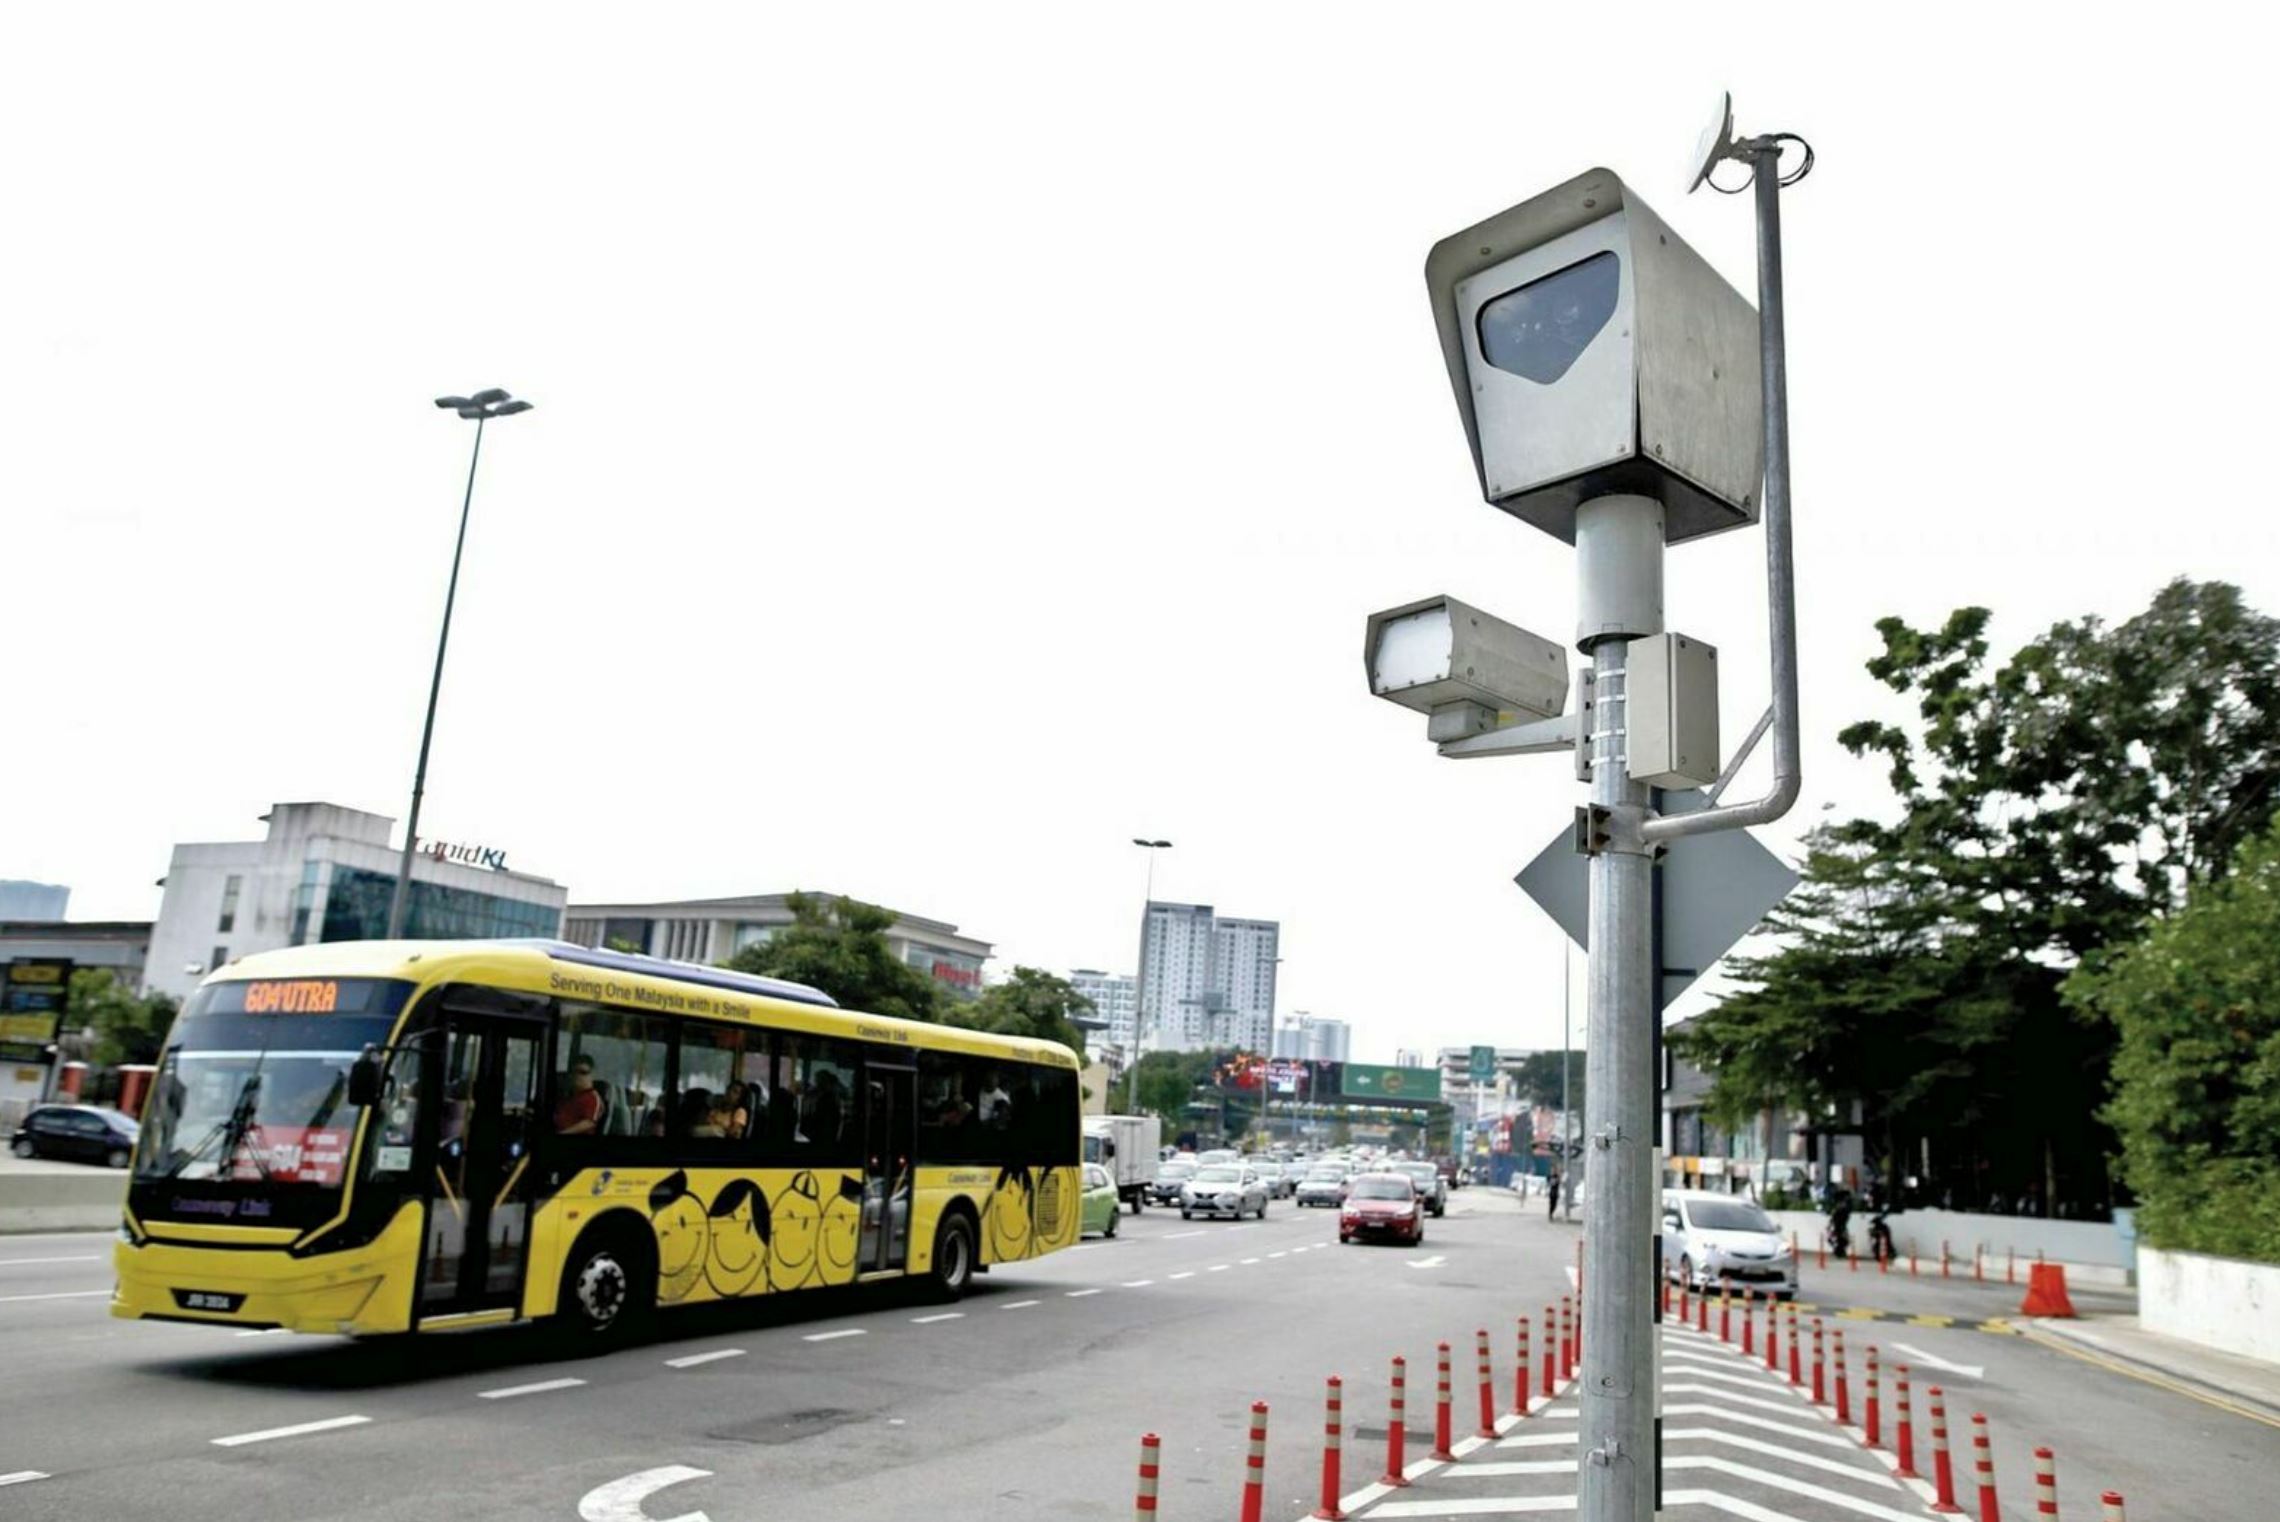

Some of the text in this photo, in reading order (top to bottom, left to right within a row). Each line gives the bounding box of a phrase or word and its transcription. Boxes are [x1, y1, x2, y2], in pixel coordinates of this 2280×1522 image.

[550, 972, 602, 1000] Serving
[606, 982, 632, 1000] One
[635, 987, 684, 1009] Malaysia
[687, 996, 711, 1010] with
[722, 1000, 751, 1020] Smile
